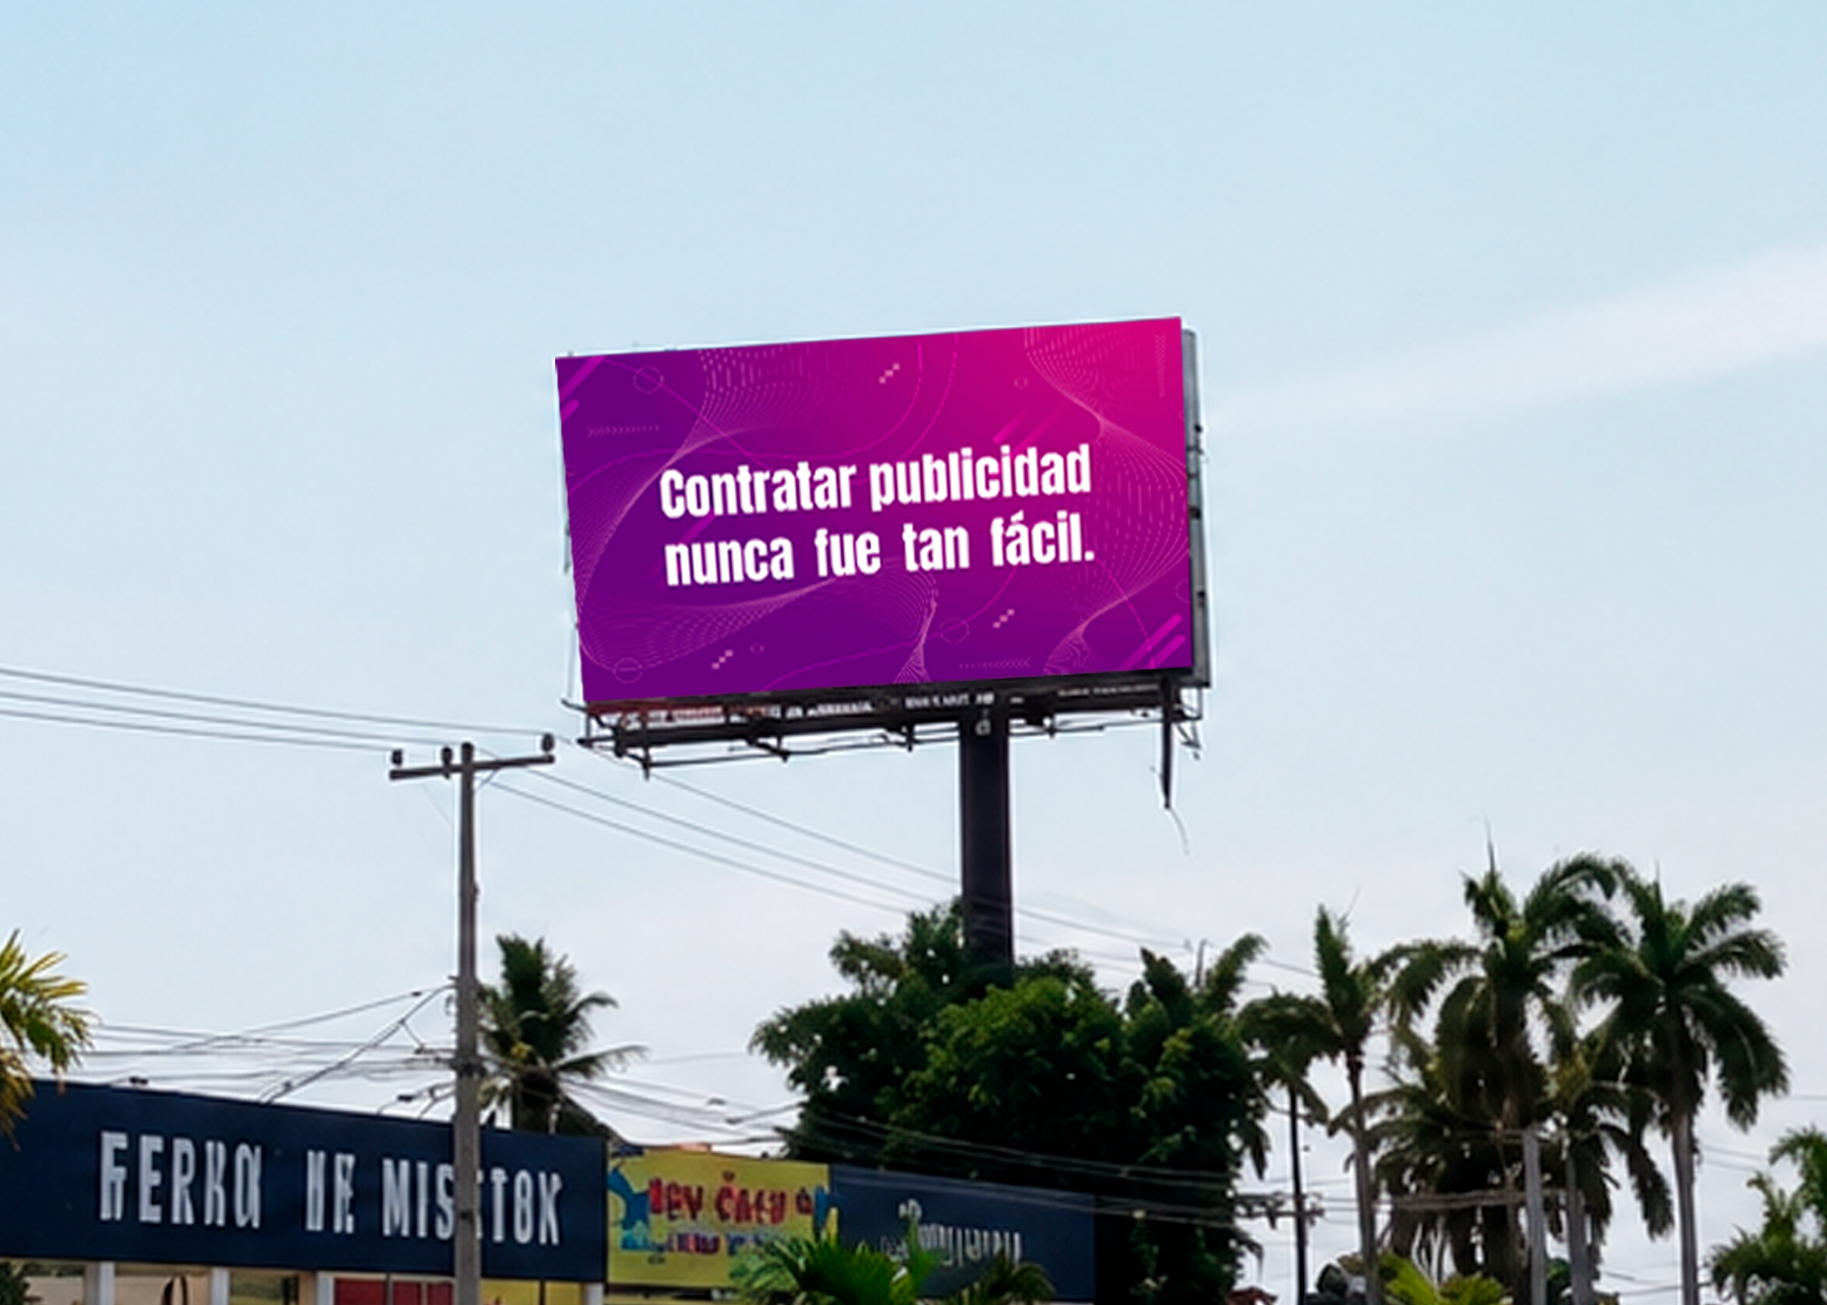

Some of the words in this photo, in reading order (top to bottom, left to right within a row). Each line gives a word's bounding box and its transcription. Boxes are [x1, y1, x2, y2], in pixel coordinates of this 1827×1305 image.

[660, 461, 857, 518] Contratar
[869, 444, 1091, 512] publicidad
[665, 537, 794, 586] nunca
[814, 528, 881, 577] fue
[902, 523, 970, 572] tan
[990, 510, 1095, 567] fácil.
